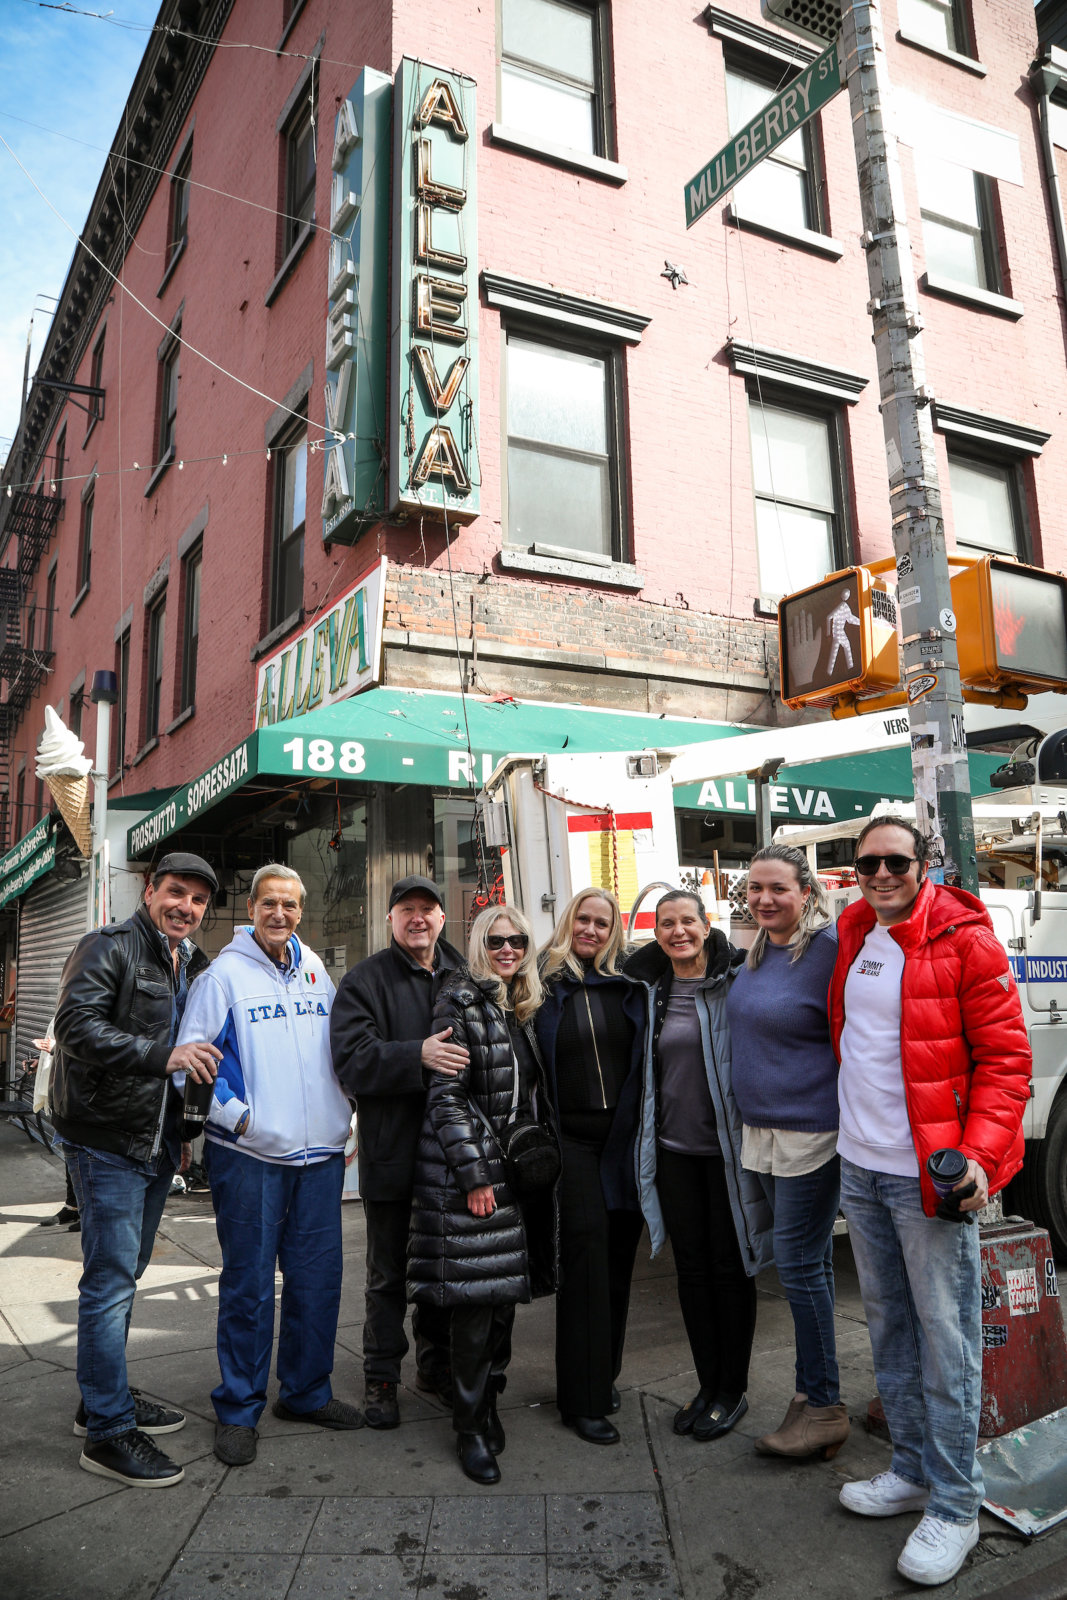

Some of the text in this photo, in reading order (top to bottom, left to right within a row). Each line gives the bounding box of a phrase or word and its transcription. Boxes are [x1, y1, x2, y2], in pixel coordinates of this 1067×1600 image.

[689, 51, 835, 217] MULBERRY ST
[321, 99, 360, 518] ALLEVA
[412, 78, 471, 494] ALLEVA
[257, 586, 371, 728] ALLEVA
[131, 802, 176, 854] PROSCIUTTO
[187, 743, 248, 816] SOPRESSATA
[283, 737, 366, 774] 188
[449, 750, 506, 783] RI
[248, 1001, 328, 1023] ITALIA
[861, 959, 885, 970] TOMMY
